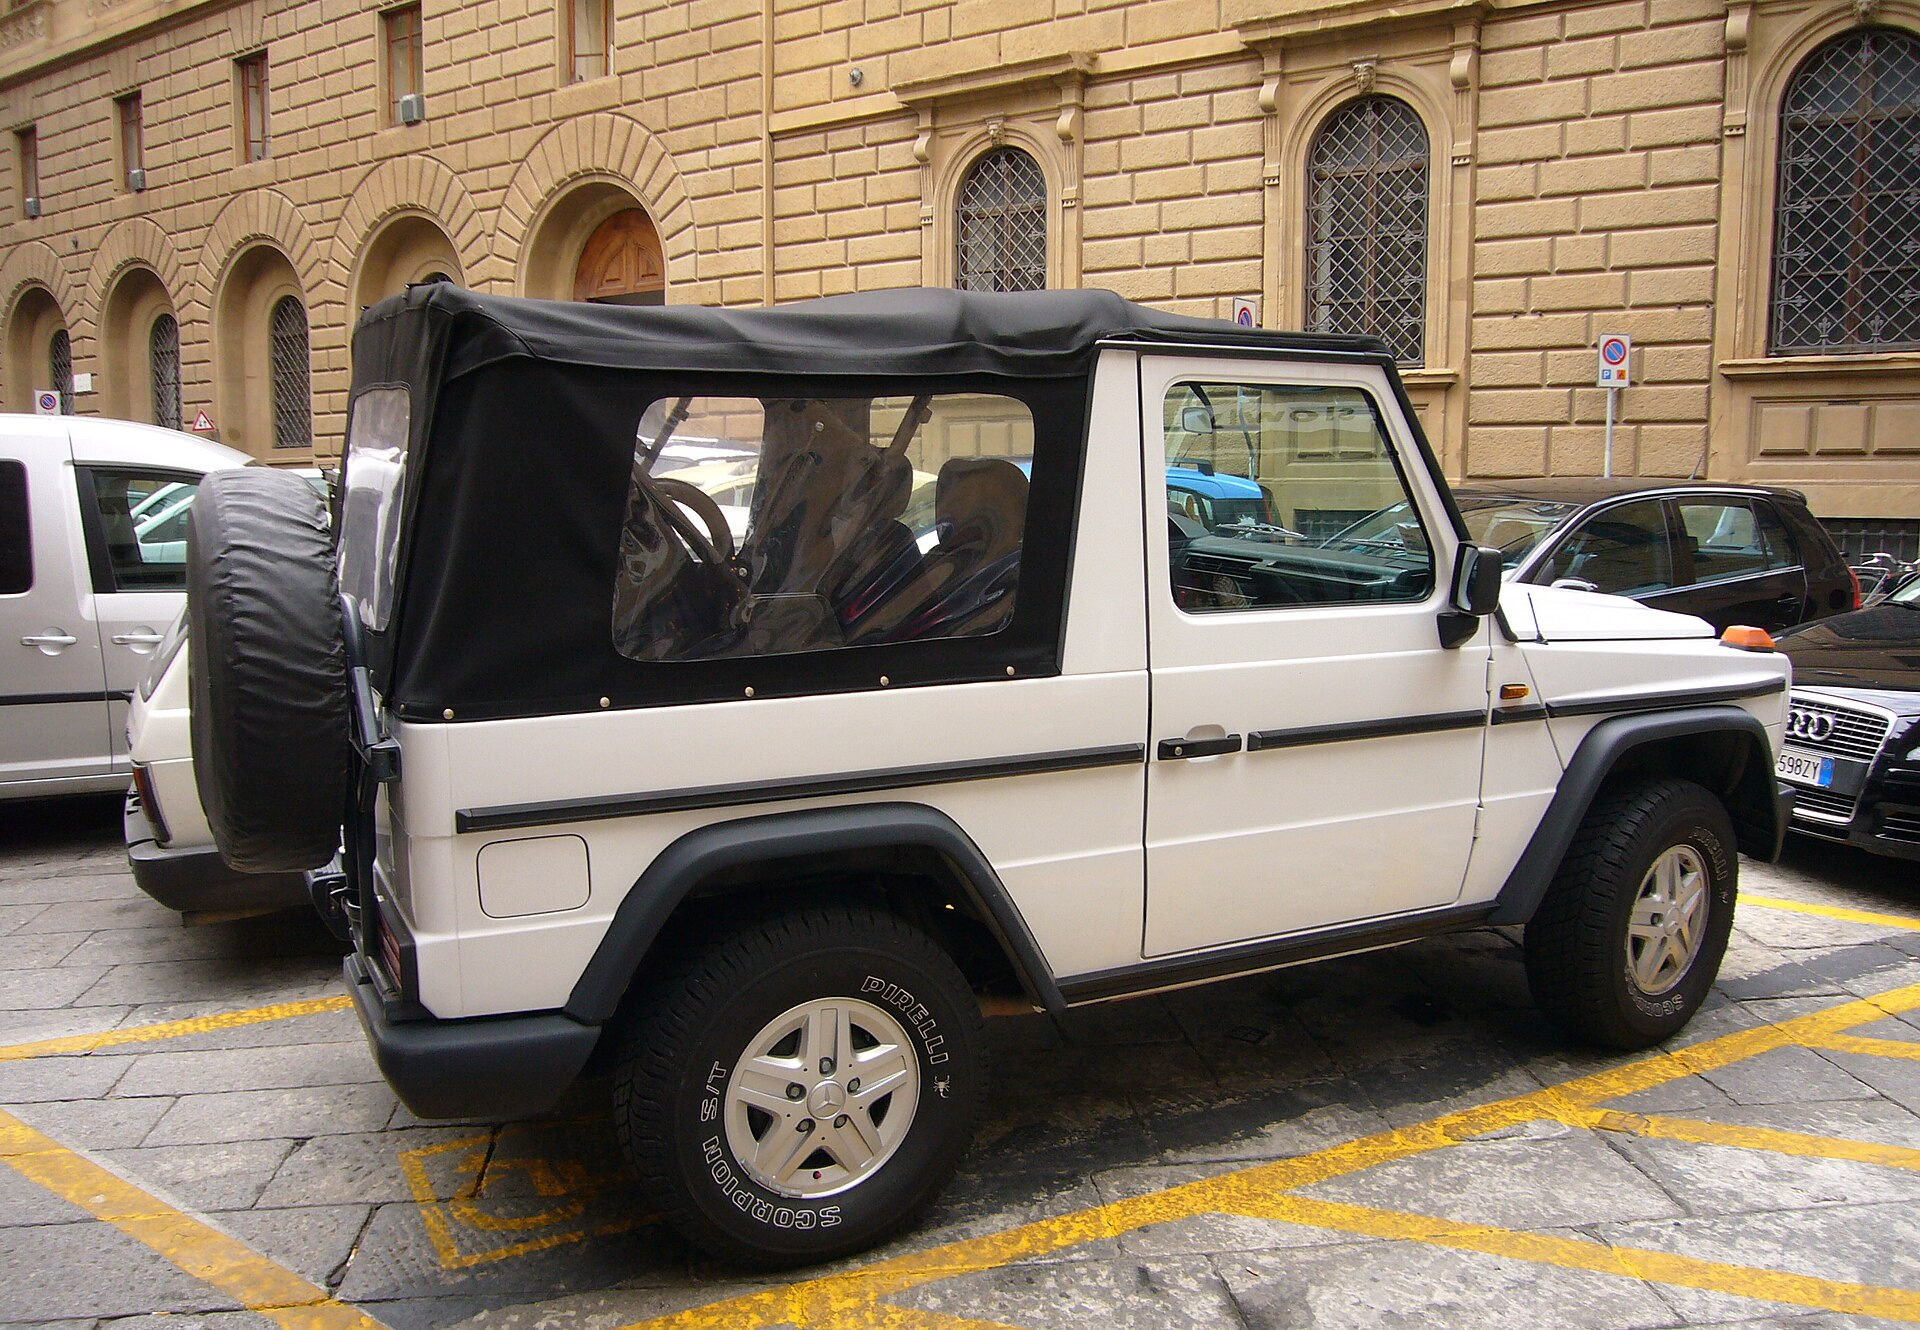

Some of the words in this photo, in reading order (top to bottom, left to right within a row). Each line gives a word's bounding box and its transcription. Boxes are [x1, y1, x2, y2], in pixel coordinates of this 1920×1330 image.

[1603, 370, 1611, 379] P
[1778, 755, 1819, 780] 598ZY
[861, 975, 949, 1065] PIRELLI
[701, 1061, 727, 1122] S/T
[702, 1135, 842, 1229] SCORPION
